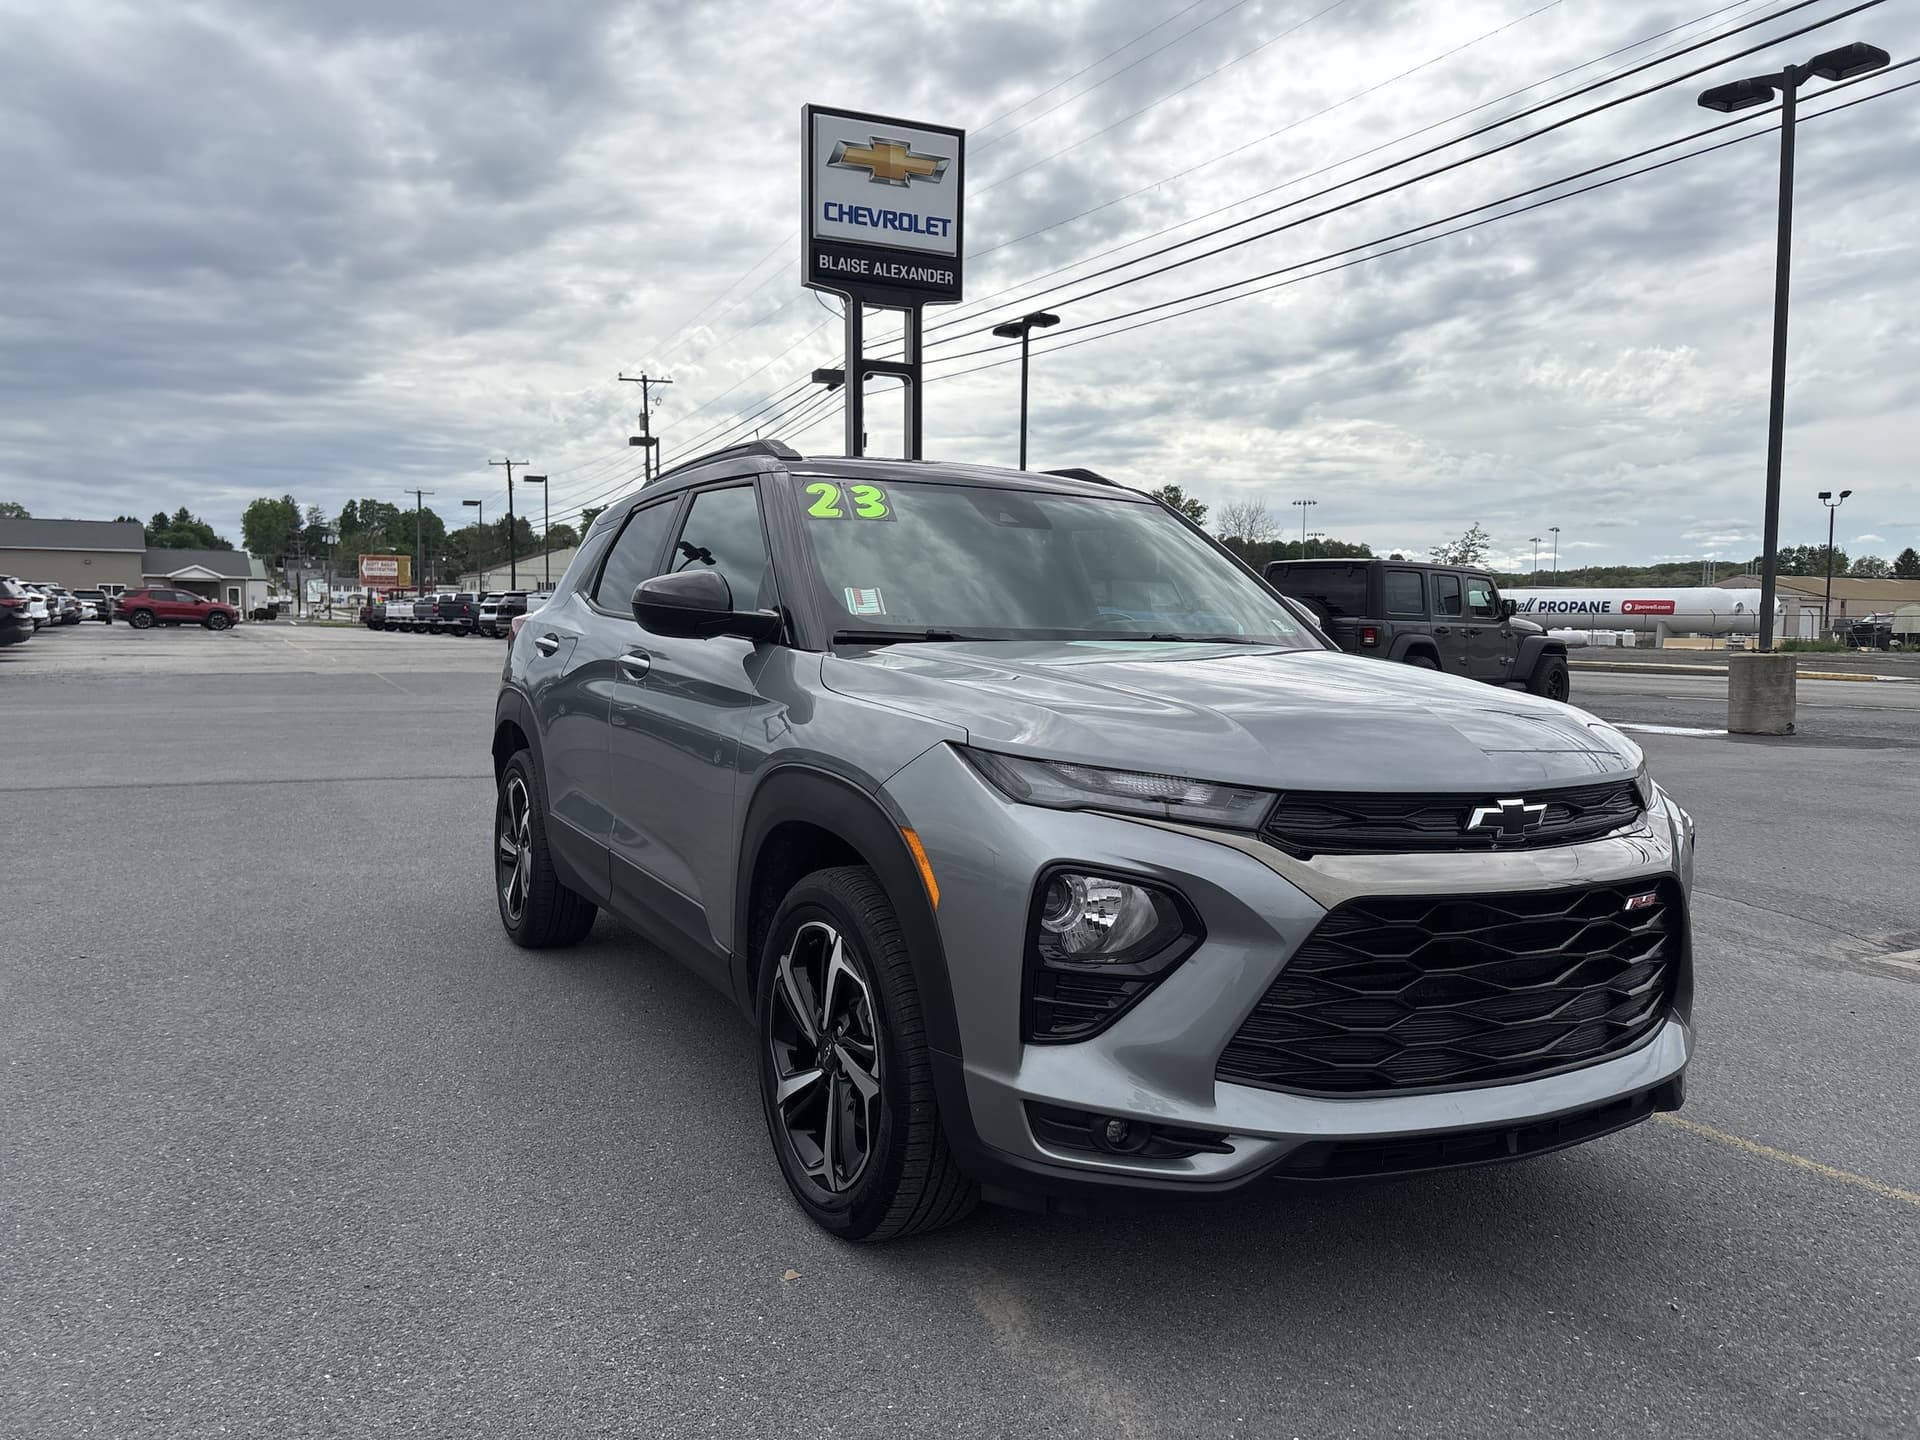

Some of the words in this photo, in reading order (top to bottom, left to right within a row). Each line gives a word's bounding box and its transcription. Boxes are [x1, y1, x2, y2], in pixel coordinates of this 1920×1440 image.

[824, 202, 951, 237] CHEVROLET
[819, 254, 869, 274] BLAISE
[873, 262, 954, 285] ALEXANDER
[806, 482, 889, 518] 23
[1538, 600, 1611, 613] PROPANE
